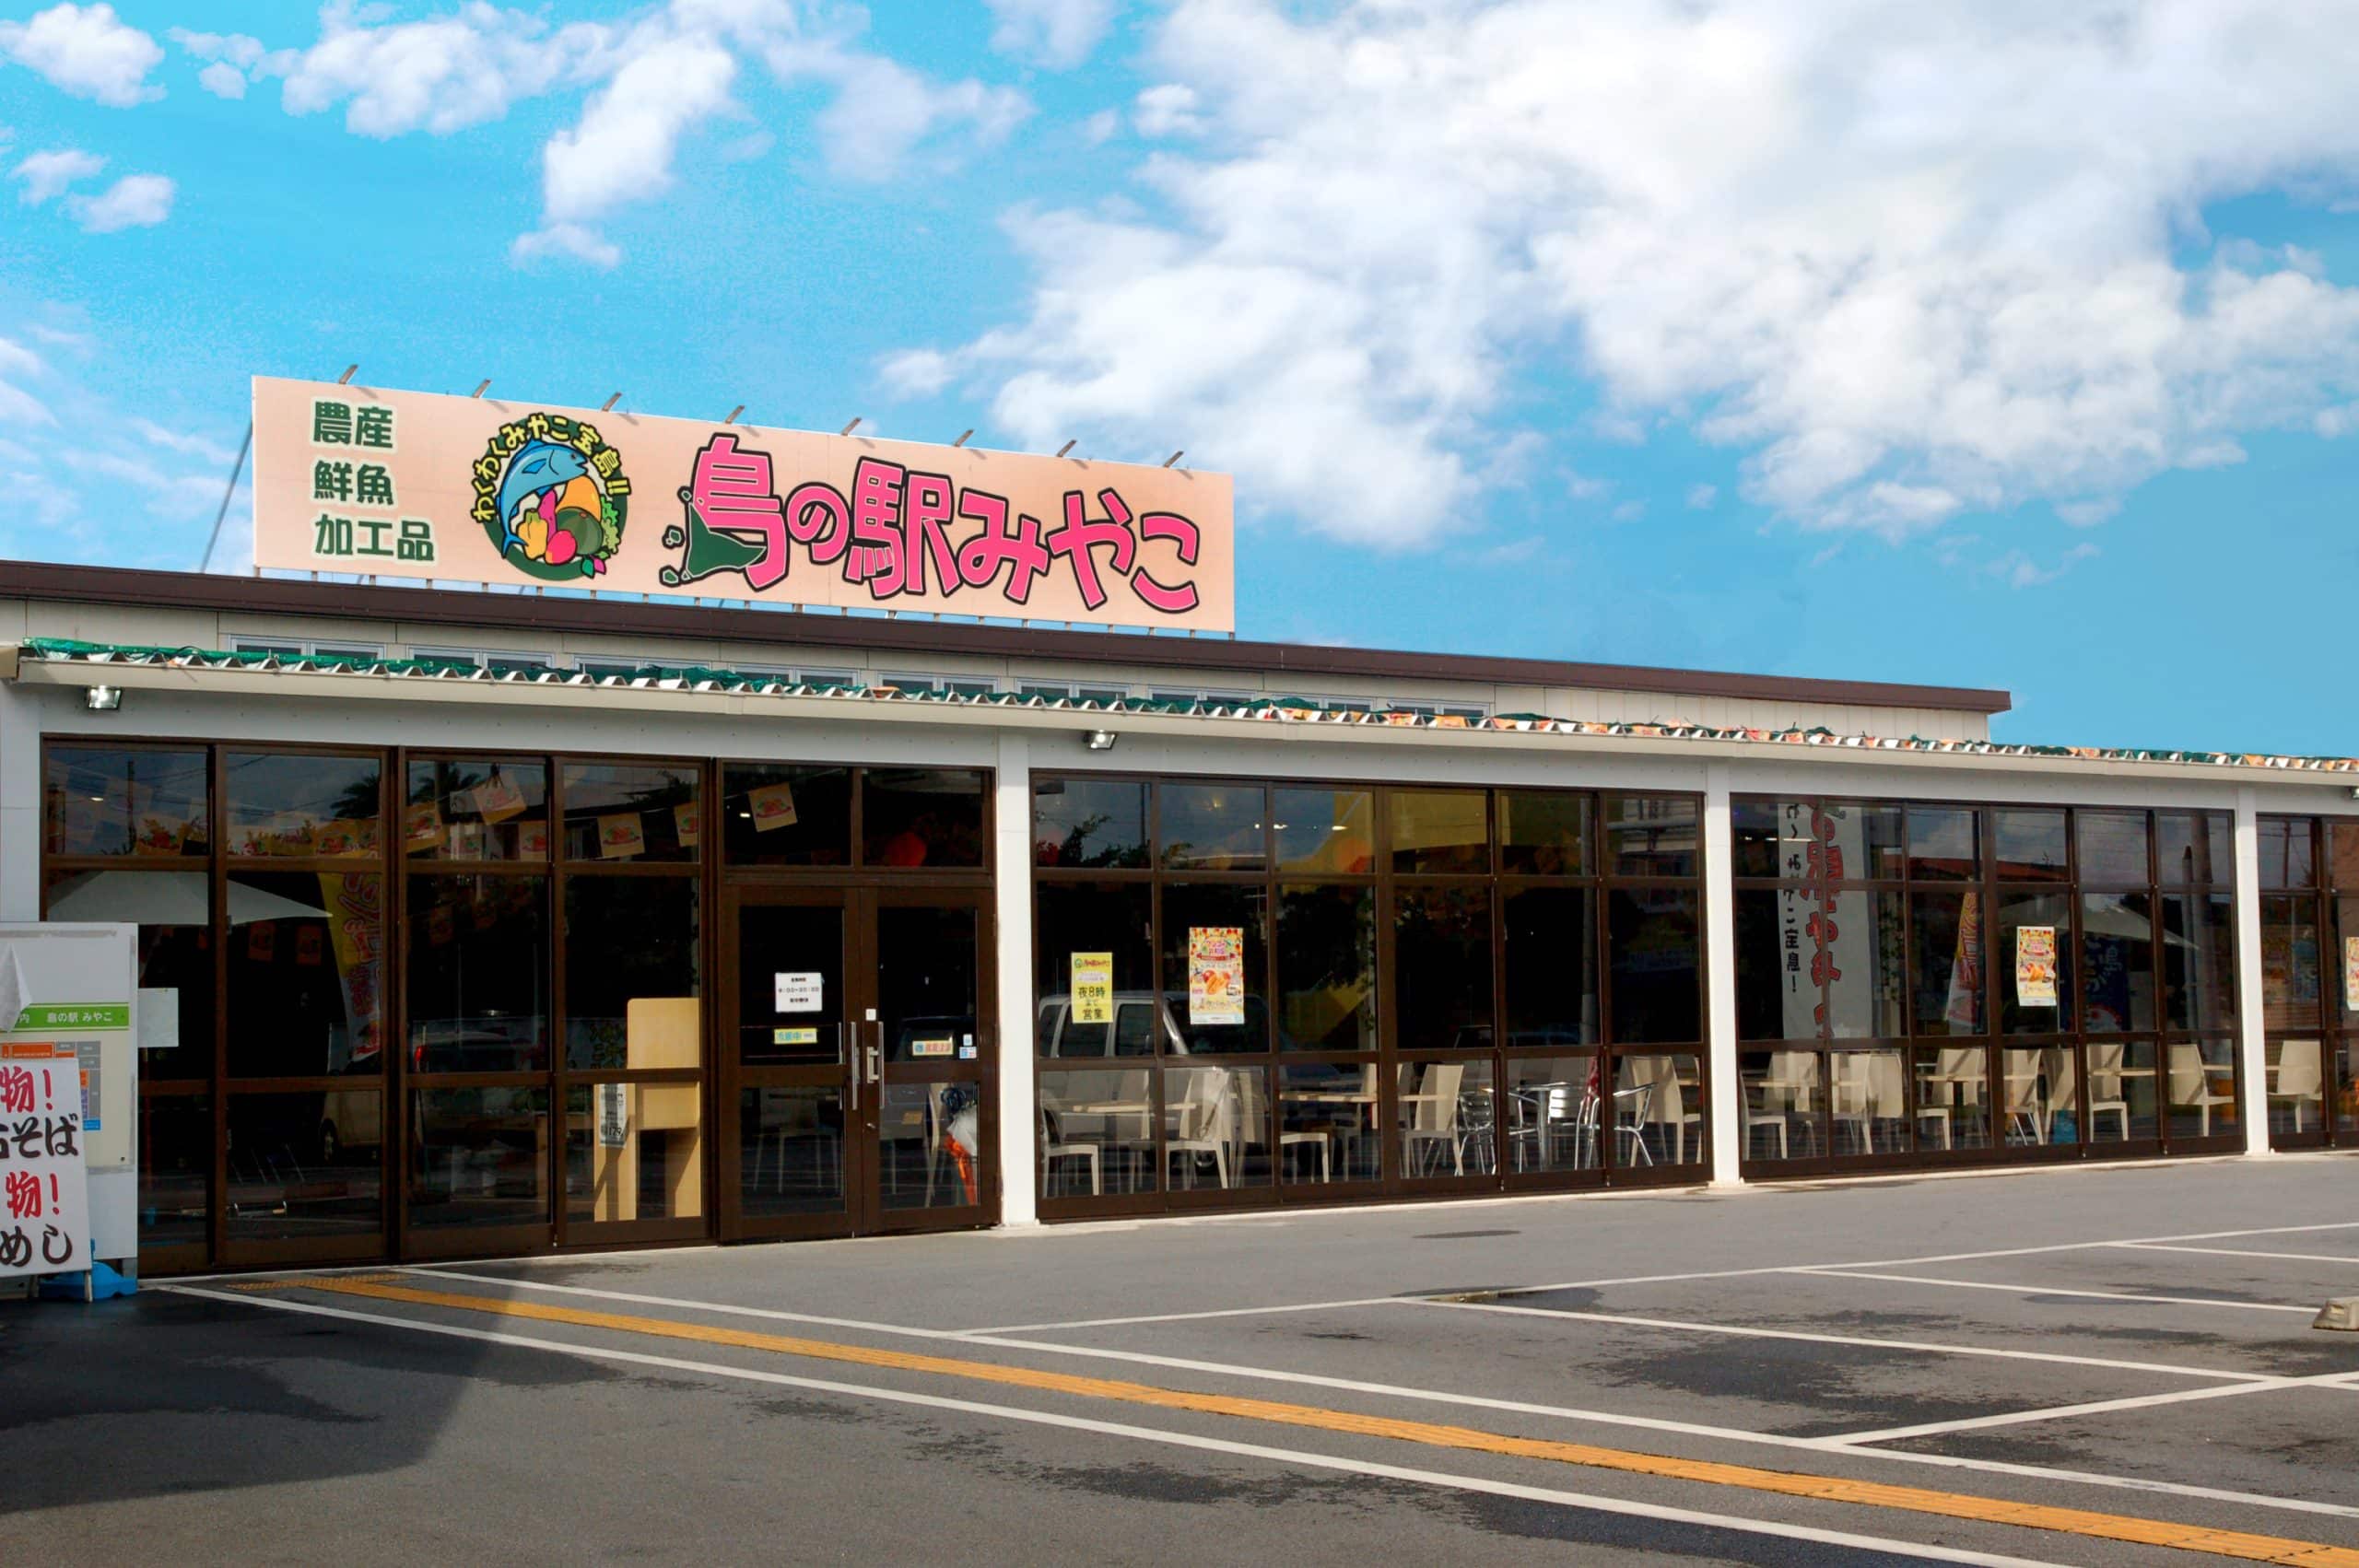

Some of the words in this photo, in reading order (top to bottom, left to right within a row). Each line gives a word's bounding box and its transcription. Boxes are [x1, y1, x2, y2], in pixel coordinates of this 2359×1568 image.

[313, 402, 393, 449] 農産
[313, 460, 393, 506] 鮮魚
[314, 513, 435, 561] 加工品
[691, 433, 1200, 613] 島の駅みやこ
